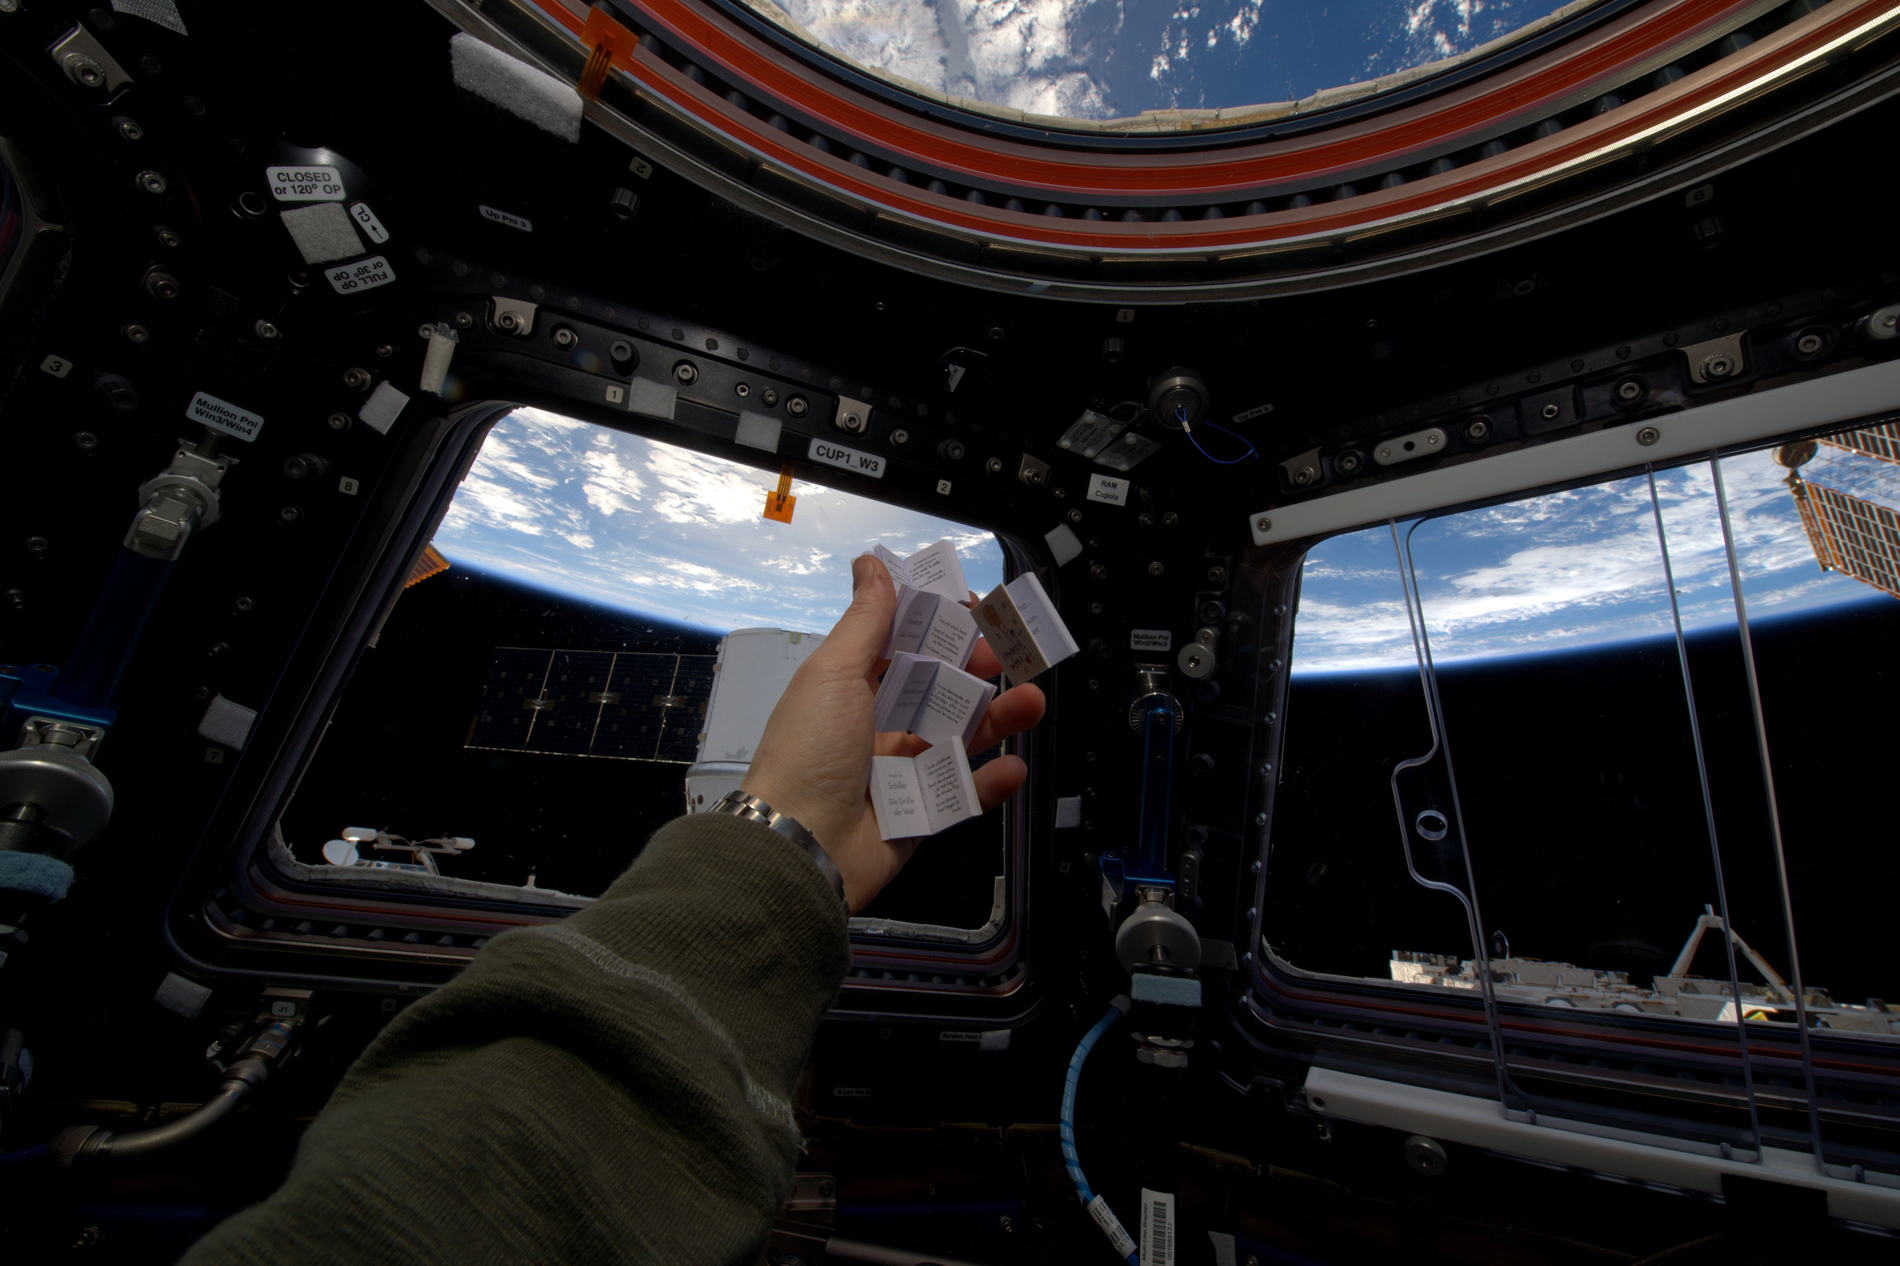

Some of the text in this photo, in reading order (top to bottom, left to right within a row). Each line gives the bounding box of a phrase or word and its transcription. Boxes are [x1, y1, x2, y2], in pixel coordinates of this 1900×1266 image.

[636, 162, 646, 173] 2
[277, 172, 332, 182] CLOSED
[274, 186, 287, 194] or
[323, 184, 341, 194] OP
[1694, 190, 1704, 200] 6
[357, 206, 371, 222] CL
[486, 210, 500, 220] Up
[502, 214, 518, 225] Pnl
[372, 261, 383, 270] or
[334, 271, 350, 282] OP
[342, 271, 388, 290] FULL OP
[50, 361, 62, 372] 3
[612, 390, 616, 400] 1
[196, 398, 258, 428] Mullion Pnl
[195, 406, 252, 435] Win3/Win4
[816, 445, 879, 472] CUP1_W3
[344, 482, 352, 491] 8
[940, 483, 948, 492] 2
[1100, 480, 1118, 490] RAM
[1095, 490, 1119, 502] Cupola
